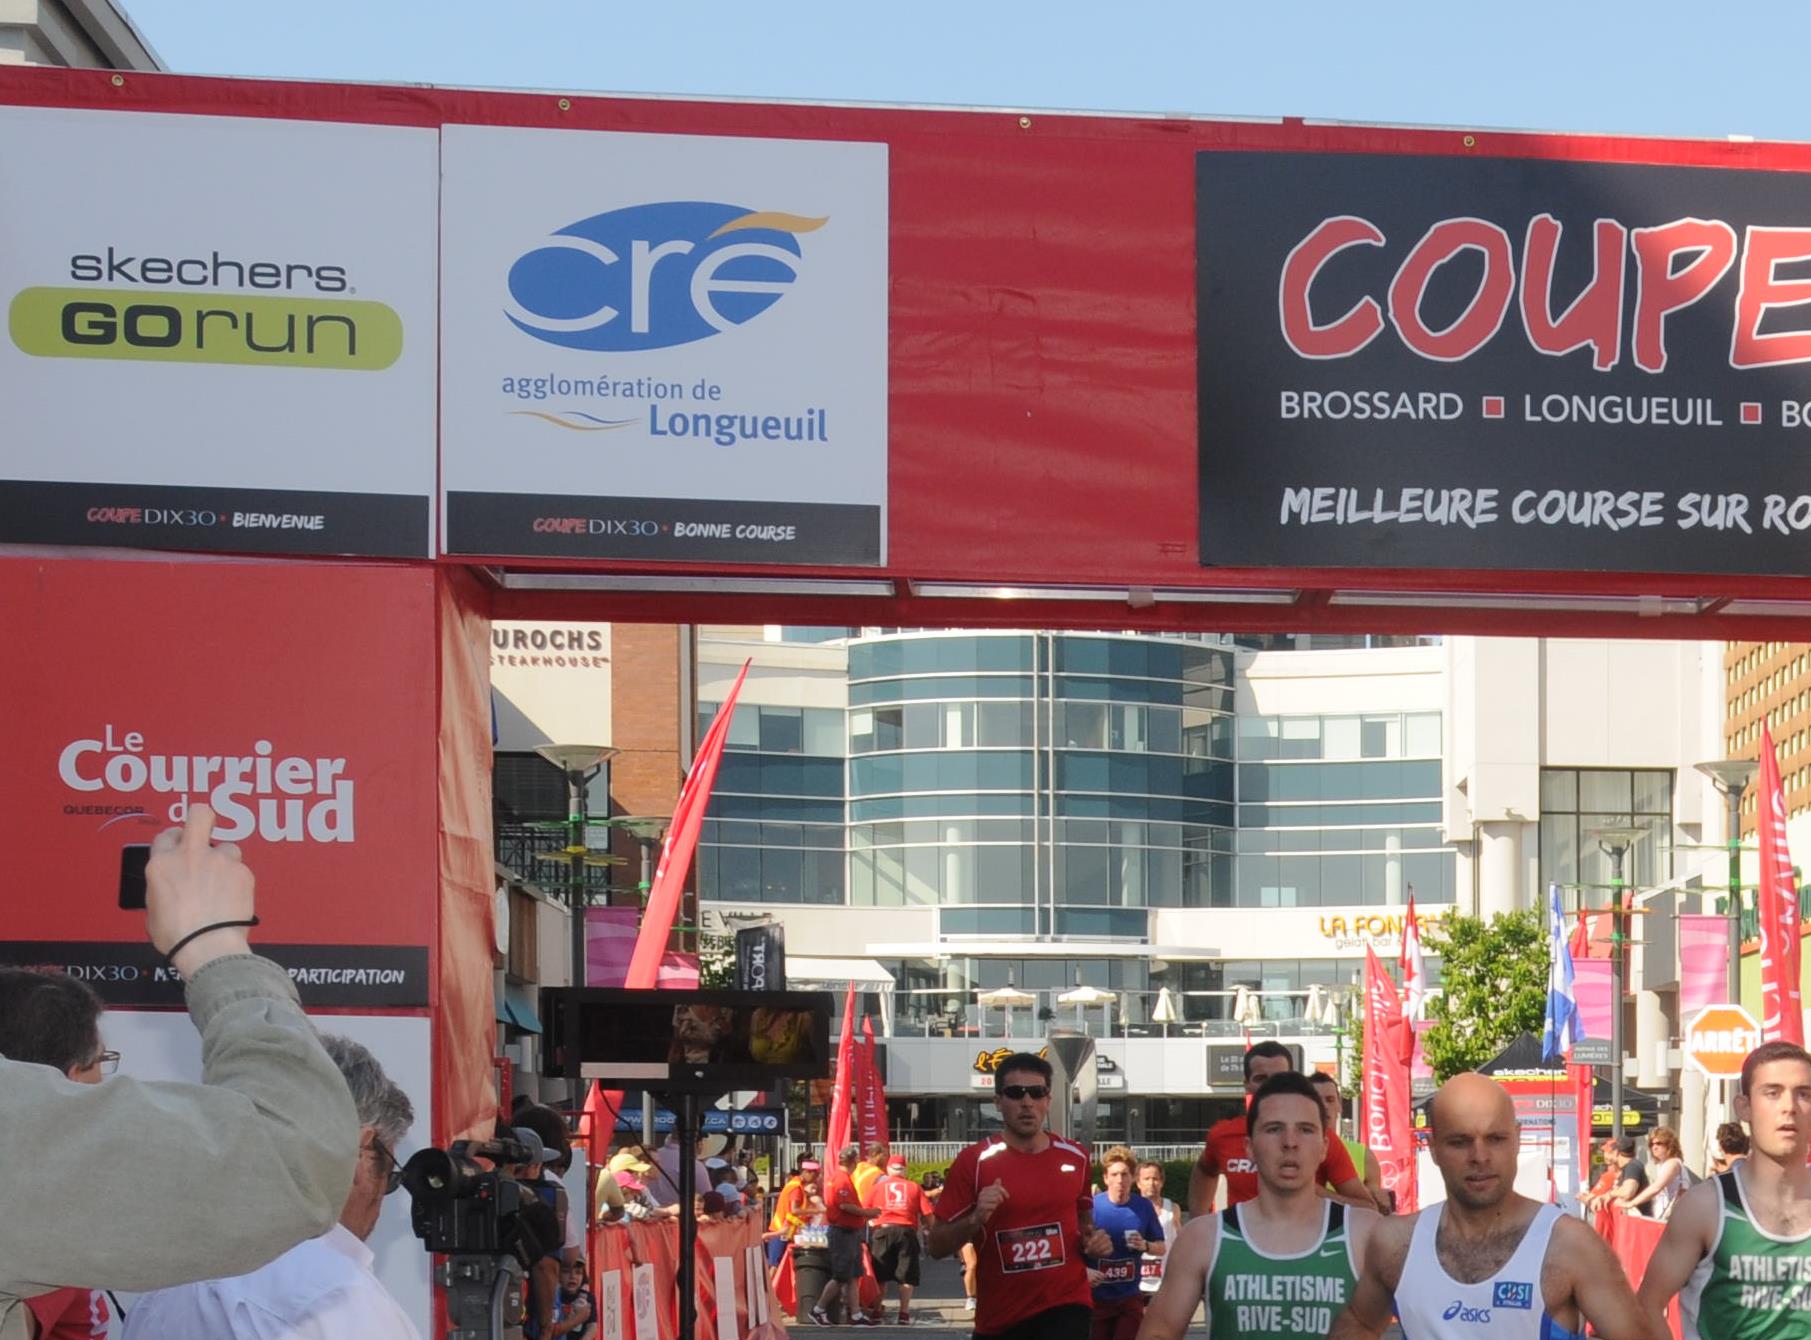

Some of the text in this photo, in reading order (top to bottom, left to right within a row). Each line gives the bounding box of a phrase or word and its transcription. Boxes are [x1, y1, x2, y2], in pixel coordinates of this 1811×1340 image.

[70, 246, 347, 293] skechers
[501, 372, 722, 401] agglomération de
[1280, 390, 1464, 420] BROSSARD
[1524, 394, 1723, 426] LONGUEUIL
[649, 404, 829, 447] Longueuil
[232, 512, 325, 530] BIENVENUE
[1280, 486, 1500, 529] MEILLEURE
[1511, 489, 1665, 532] COURSE
[1676, 492, 1753, 535] SUR
[673, 522, 732, 539] BONNE
[736, 523, 797, 541] COURSE
[106, 725, 144, 752] Le
[58, 739, 346, 795] Courrier
[210, 780, 355, 843] Sud
[1319, 915, 1347, 938] LA
[288, 968, 405, 985] PARTICIPATION
[1690, 1027, 1758, 1053] ARRÊT
[1012, 1239, 1051, 1262] 222
[1224, 1274, 1345, 1304] ATHLETISME
[1237, 1305, 1331, 1335] RIVE-SUD
[1460, 1307, 1491, 1323] asics
